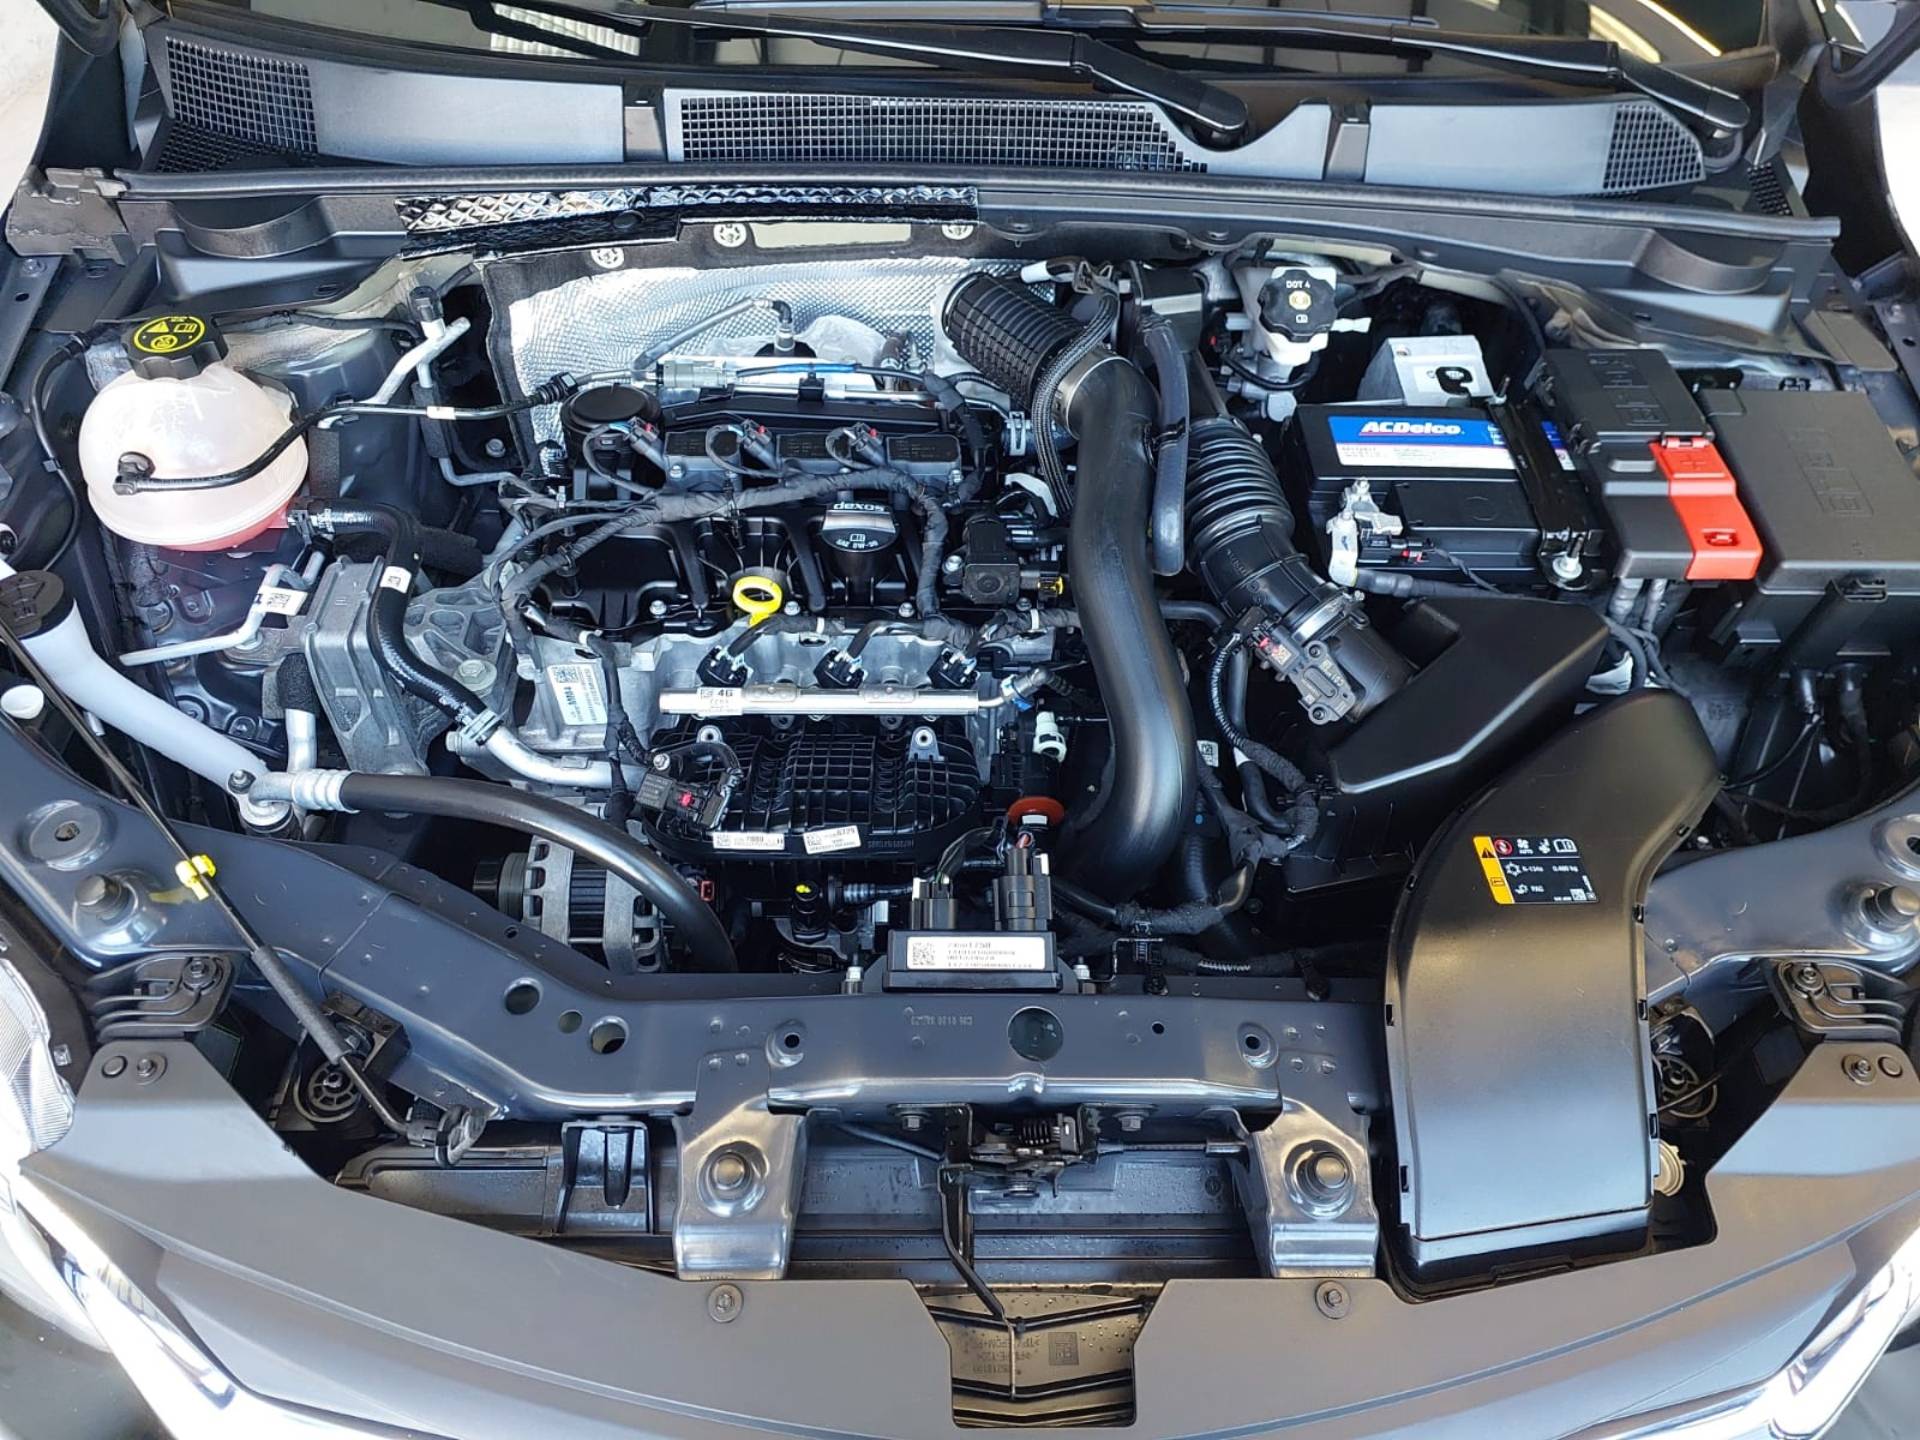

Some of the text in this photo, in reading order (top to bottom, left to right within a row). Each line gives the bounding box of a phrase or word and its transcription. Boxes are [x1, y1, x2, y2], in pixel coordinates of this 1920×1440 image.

[1285, 280, 1311, 288] DOT 4
[1360, 421, 1461, 435] ACDelco
[833, 502, 884, 511] dexos
